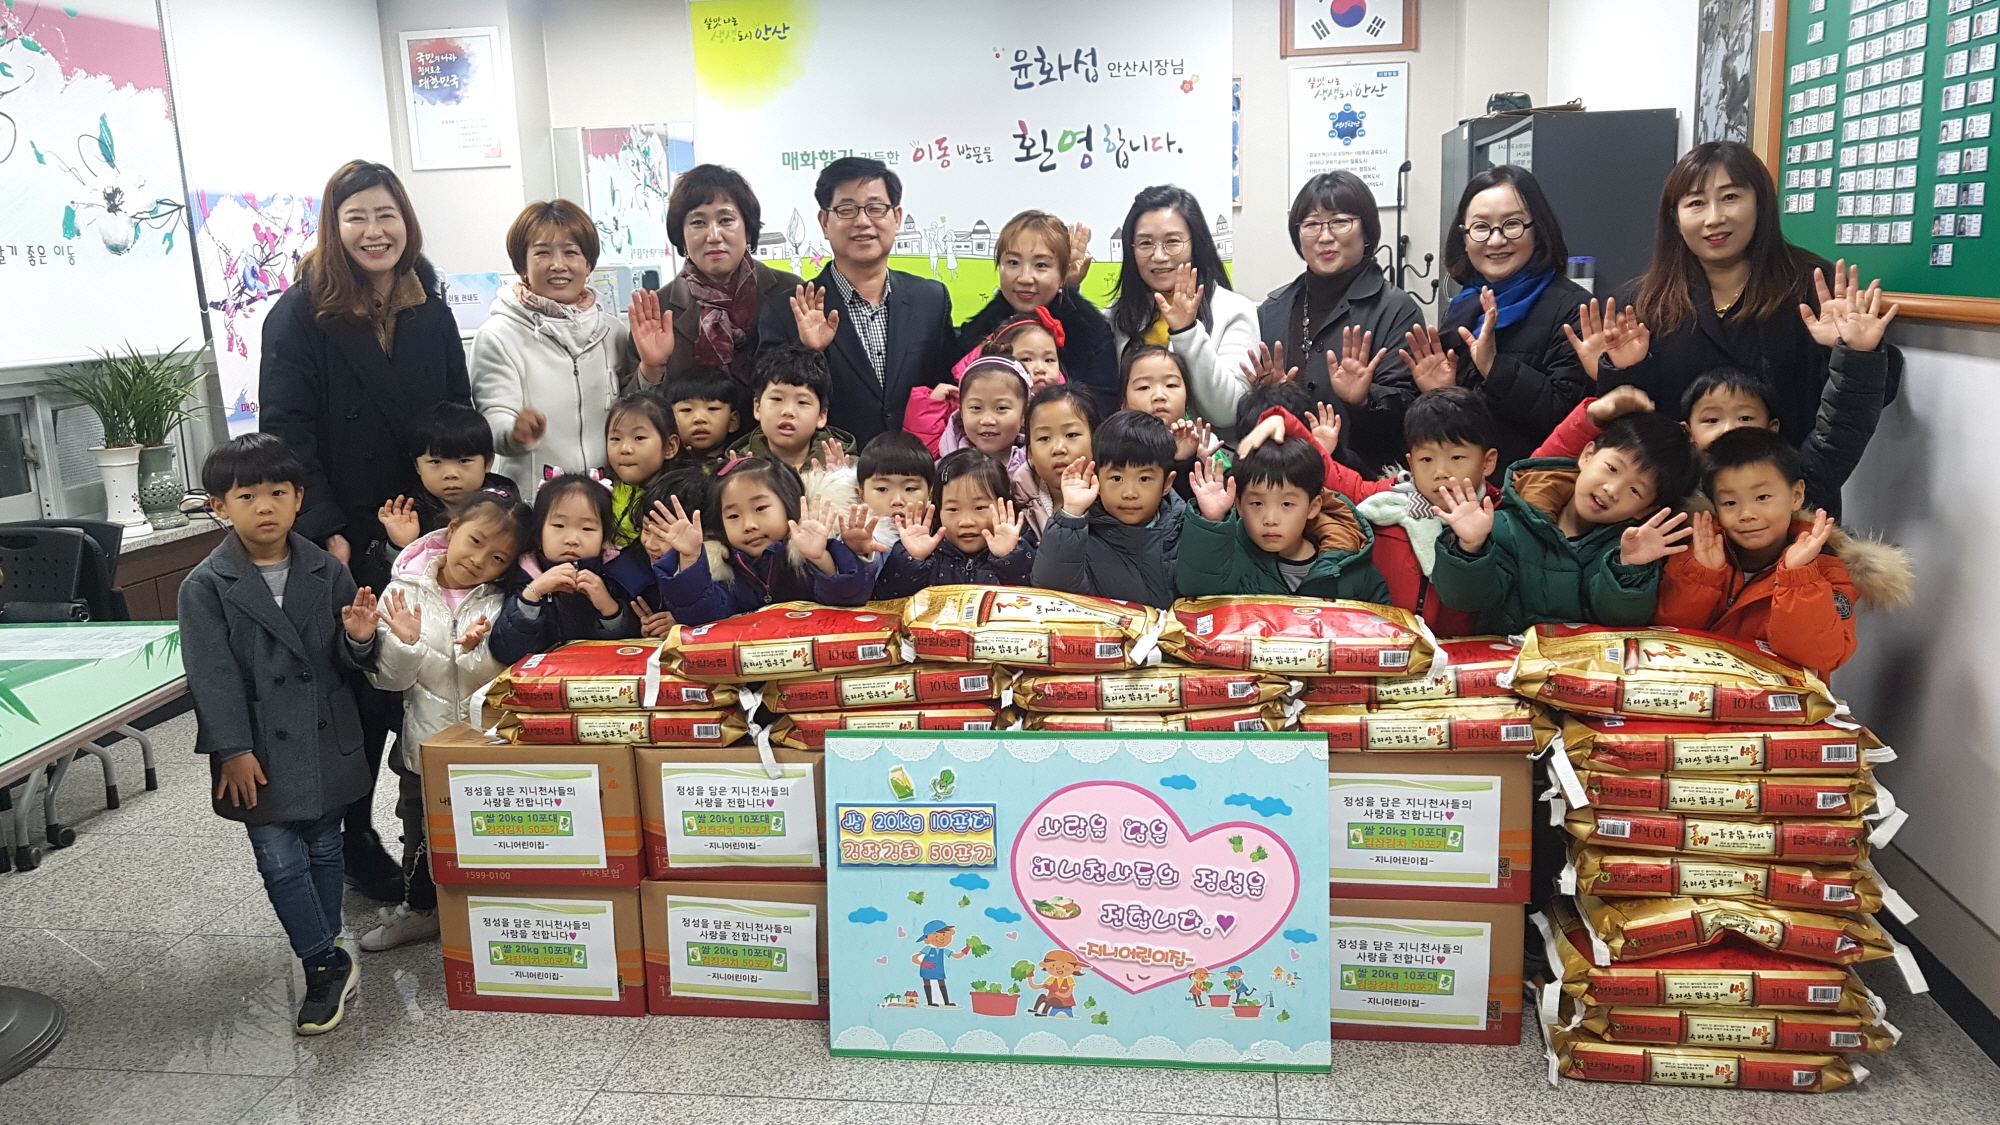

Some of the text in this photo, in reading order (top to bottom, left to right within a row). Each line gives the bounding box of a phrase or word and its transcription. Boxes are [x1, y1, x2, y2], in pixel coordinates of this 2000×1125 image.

[704, 17, 738, 30] 살맛 나는
[755, 23, 790, 40] 안산
[1010, 45, 1184, 90] 윤화섭 안산시장님
[419, 74, 459, 89] 대한민국
[913, 137, 950, 168] 이동
[957, 144, 994, 163] 방문을
[27, 245, 47, 266] 좋은
[54, 245, 75, 265] 이동
[464, 786, 576, 796] 정성을 담은 지니천사들의
[677, 786, 789, 796] 정성을 담은 지니천사들의
[483, 798, 553, 807] 사랑을 전합니다
[695, 798, 765, 808] 사랑을 전합니다
[1343, 797, 1472, 809] 정성을 담은 지니천사들의
[486, 814, 558, 823] 쌀 20kg 10포대
[698, 815, 769, 824] 쌀 20kg 10포대
[1363, 810, 1444, 820] 사랑을 전합니다
[842, 810, 993, 833] 쌀 20kg 10포대
[487, 825, 559, 835] 김장김치 50포기
[698, 826, 771, 835] 김장김치 50포기
[1038, 814, 1168, 844] 사랑을 담은
[1364, 826, 1446, 837] 쌀 20kg 10포대
[494, 841, 549, 849] -지니어린이집-
[1364, 838, 1447, 849] 김장김치 50포기
[842, 841, 995, 864] 김장김치 50포기
[1370, 856, 1434, 865] -지니어린이집-
[466, 871, 510, 880] 1599-0100
[1032, 856, 1266, 897] 지니천사들의 정성을
[483, 918, 590, 930] 정성을 담은 지니천사들의
[682, 918, 792, 934] 정성을 담은 지니천사들의
[501, 930, 568, 940] 사랑을 전합니다
[700, 931, 769, 942] 사랑을 전합니다
[504, 945, 572, 955] 쌀 20kg 10포대
[702, 946, 772, 957] 쌀 20kg 10포대
[1337, 939, 1462, 954] 정성을 담은 지니천사들의
[504, 956, 573, 966] 김장김치 50포기
[702, 957, 773, 969] 김장김치 50포기
[1357, 952, 1435, 964] 사랑을 전합니다
[510, 971, 563, 980] -지니어린이집-
[707, 973, 762, 982] -지니어린이집-
[1358, 969, 1438, 981] 쌀 20kg 10포대
[1357, 981, 1438, 992] 김장김치 50포기
[1362, 998, 1425, 1007] -지니어린이집-
